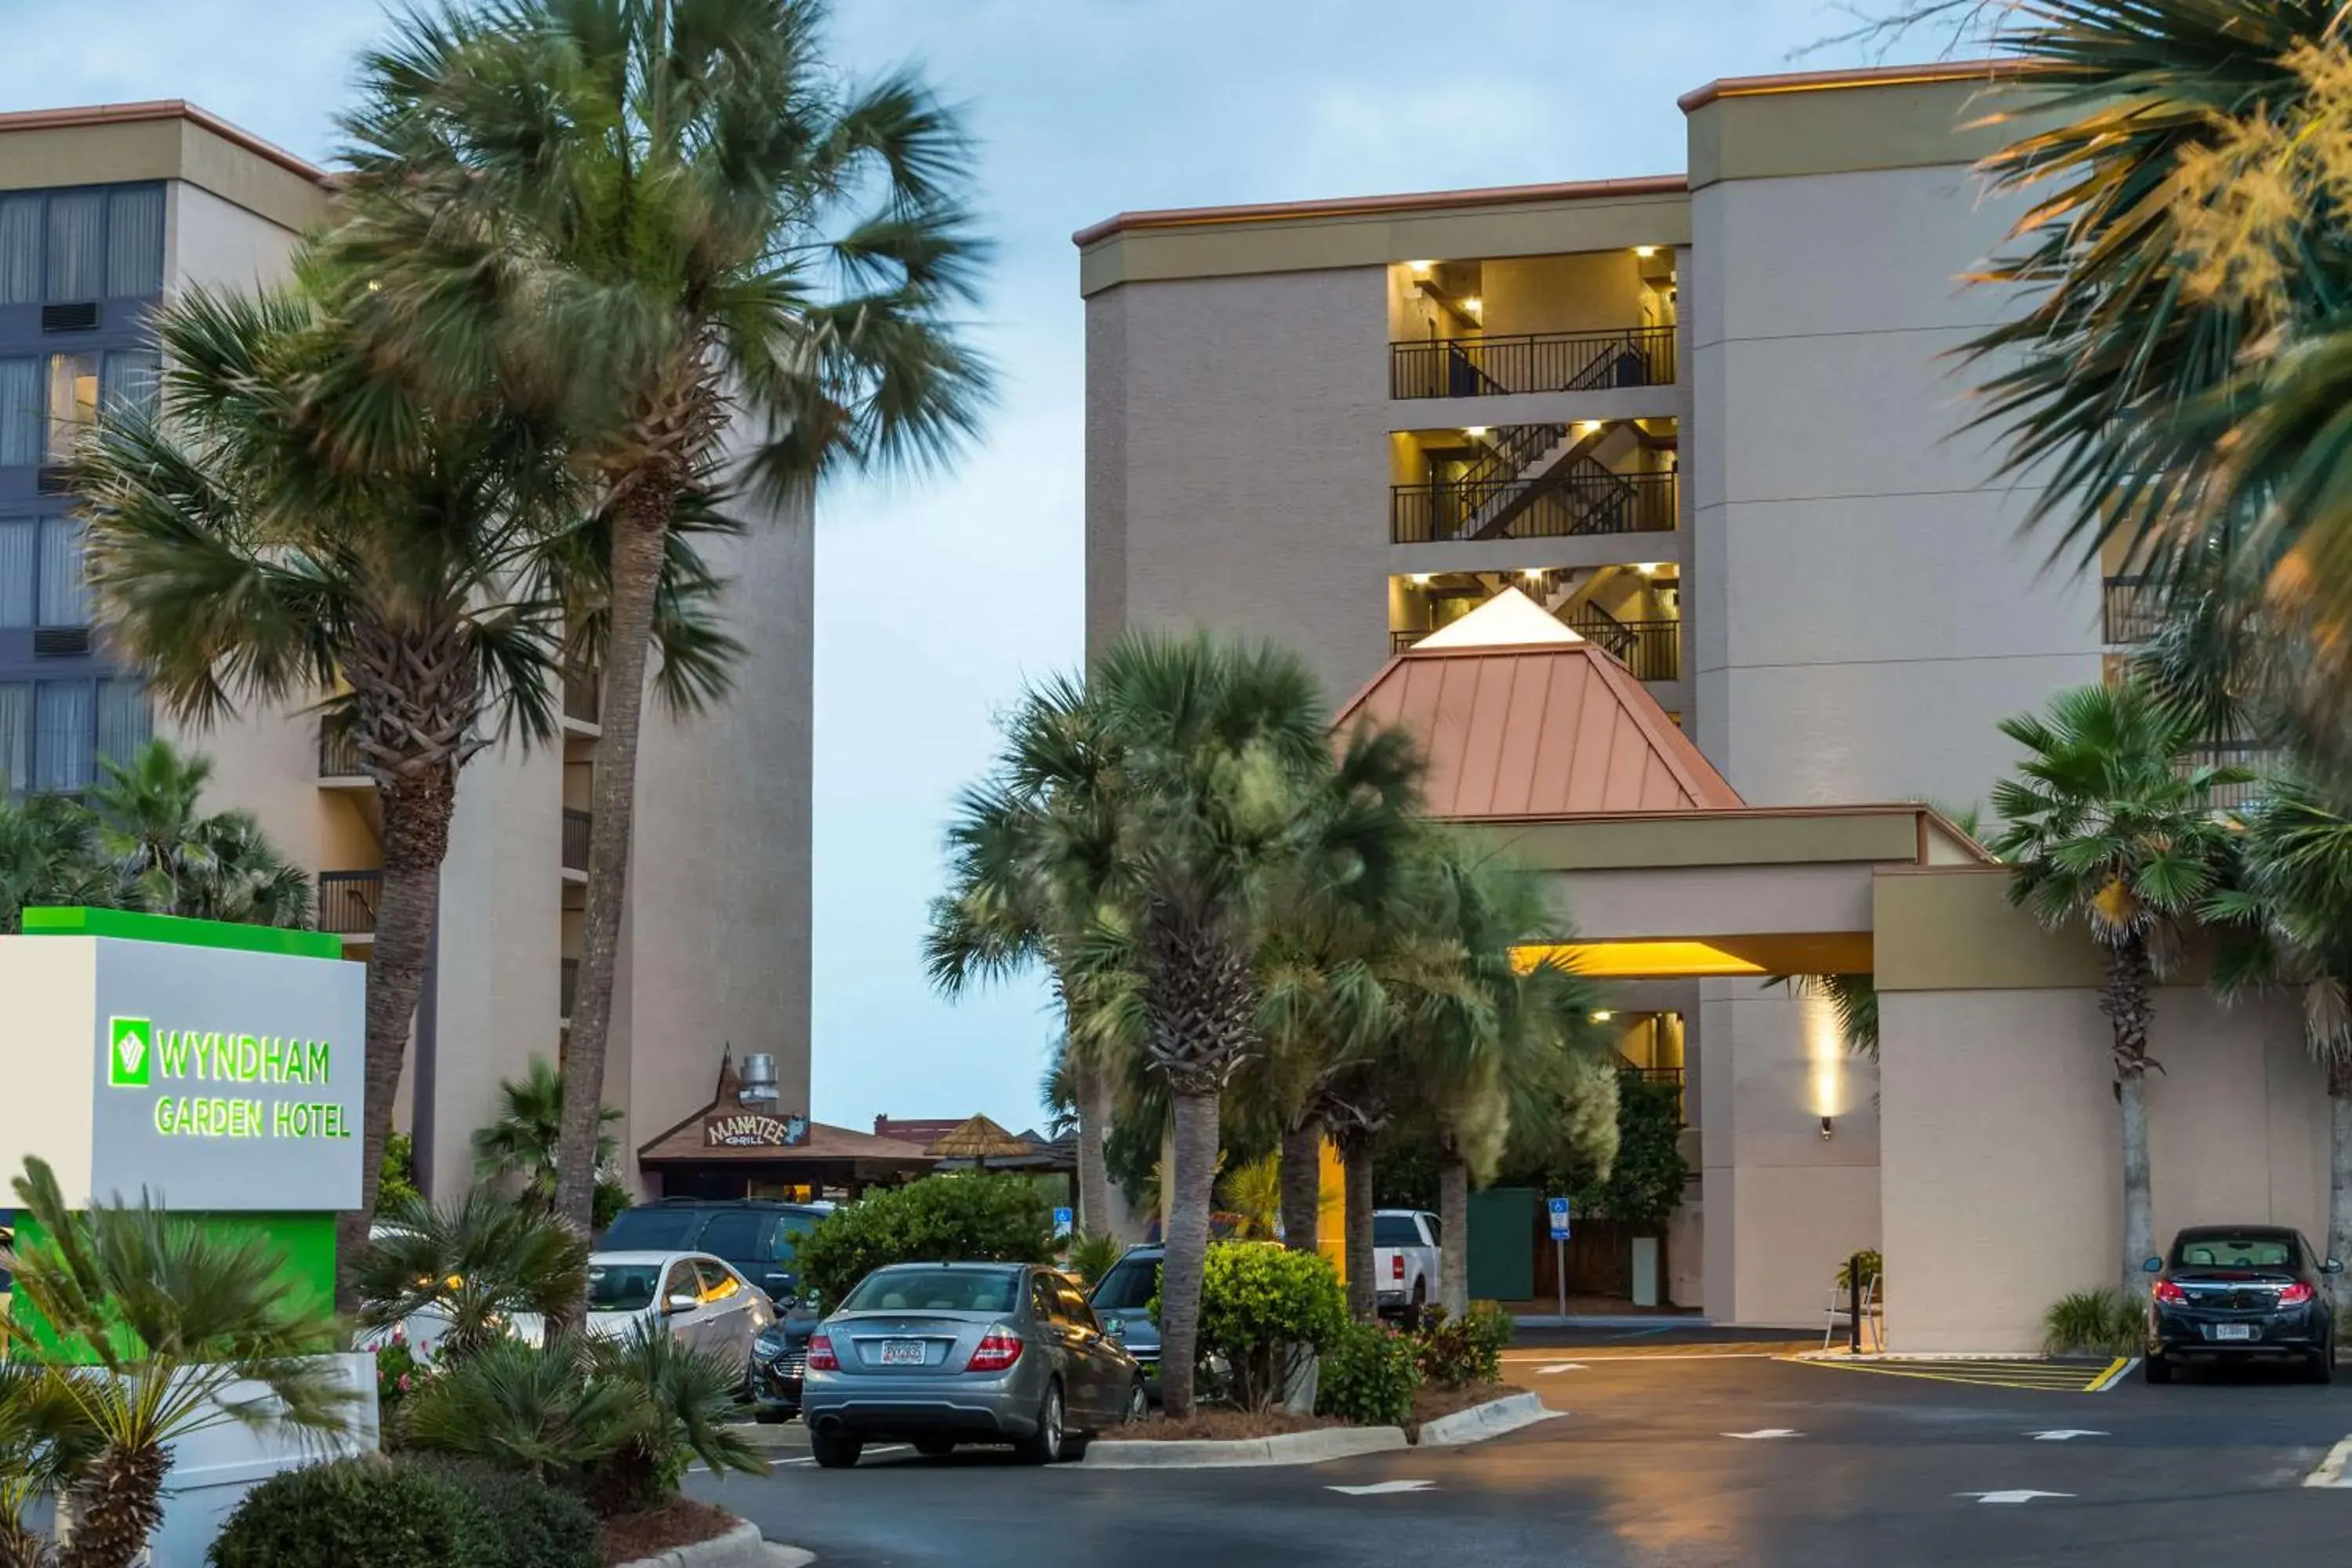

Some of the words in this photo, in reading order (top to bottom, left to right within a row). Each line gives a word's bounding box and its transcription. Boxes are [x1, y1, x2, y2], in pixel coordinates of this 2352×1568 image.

[156, 1029, 329, 1085] WYNDHAM
[154, 1095, 263, 1138] GARDEN
[273, 1101, 350, 1138] HOTEL
[708, 1116, 788, 1145] MANATEE
[724, 1135, 764, 1145] GRILL
